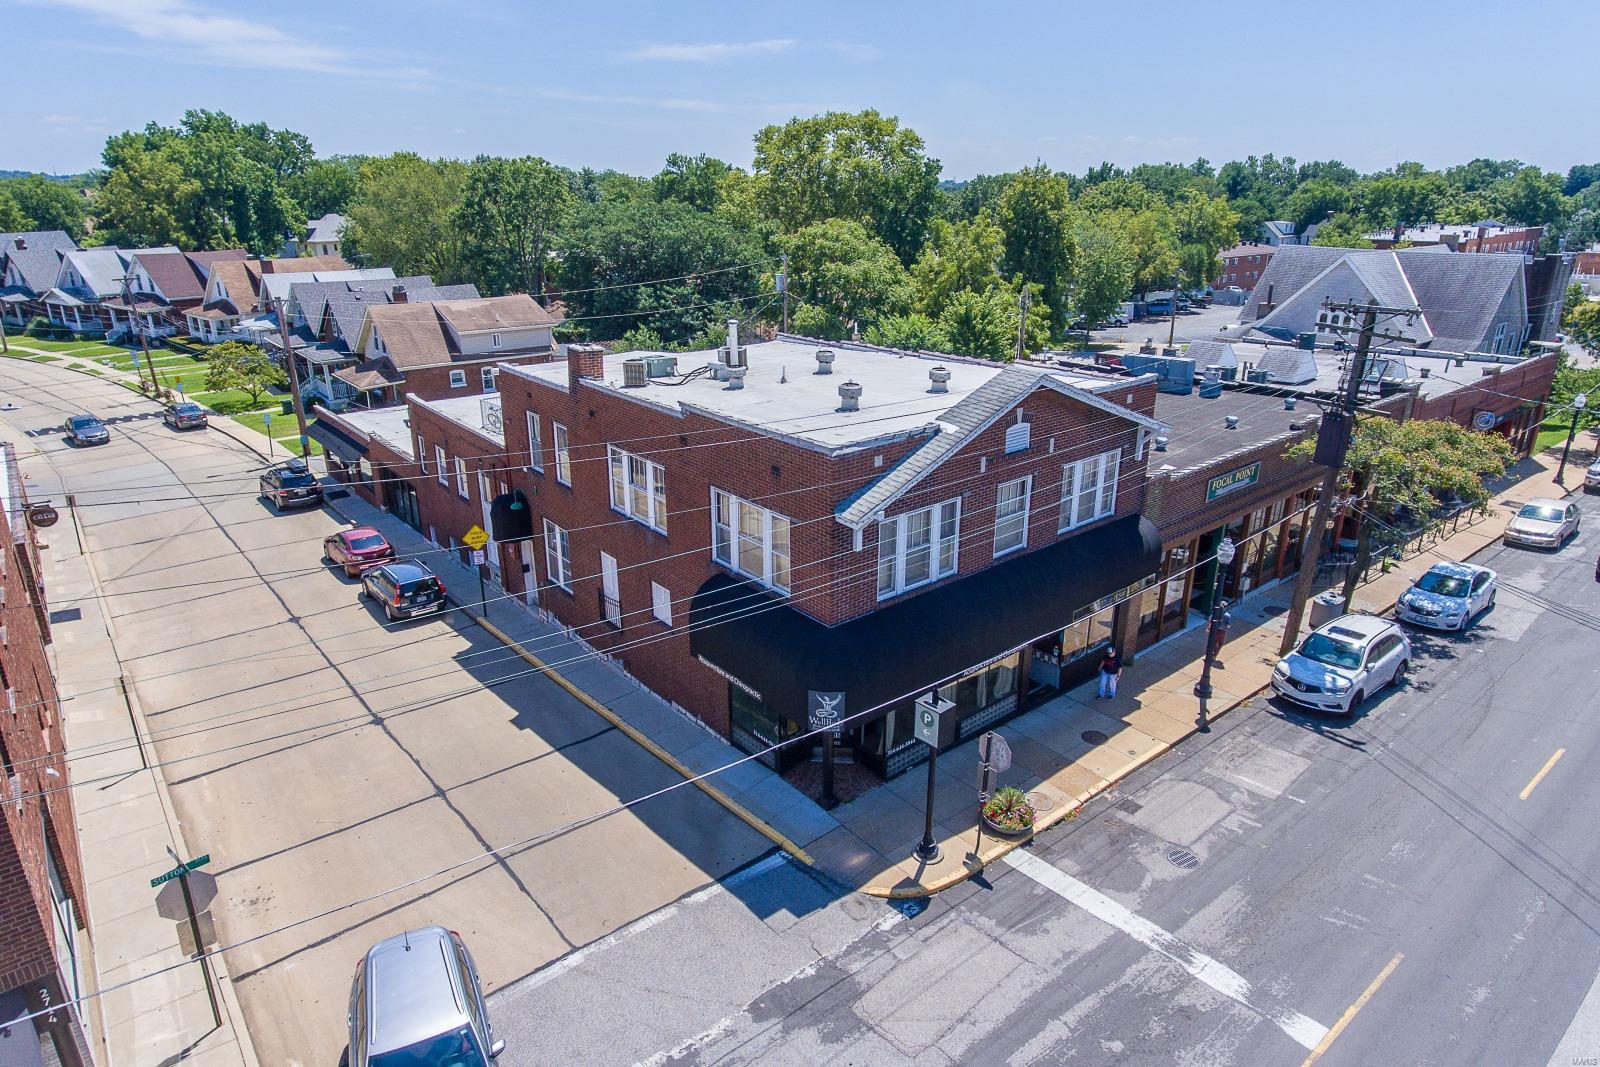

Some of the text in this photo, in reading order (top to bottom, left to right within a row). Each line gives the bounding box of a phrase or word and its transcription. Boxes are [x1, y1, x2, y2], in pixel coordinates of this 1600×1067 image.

[1212, 466, 1255, 490] FOCAL POINT
[698, 653, 725, 677] Acupuncture
[733, 677, 762, 701] Chiropractic
[925, 713, 931, 724] P
[152, 867, 184, 886] SUTTON
